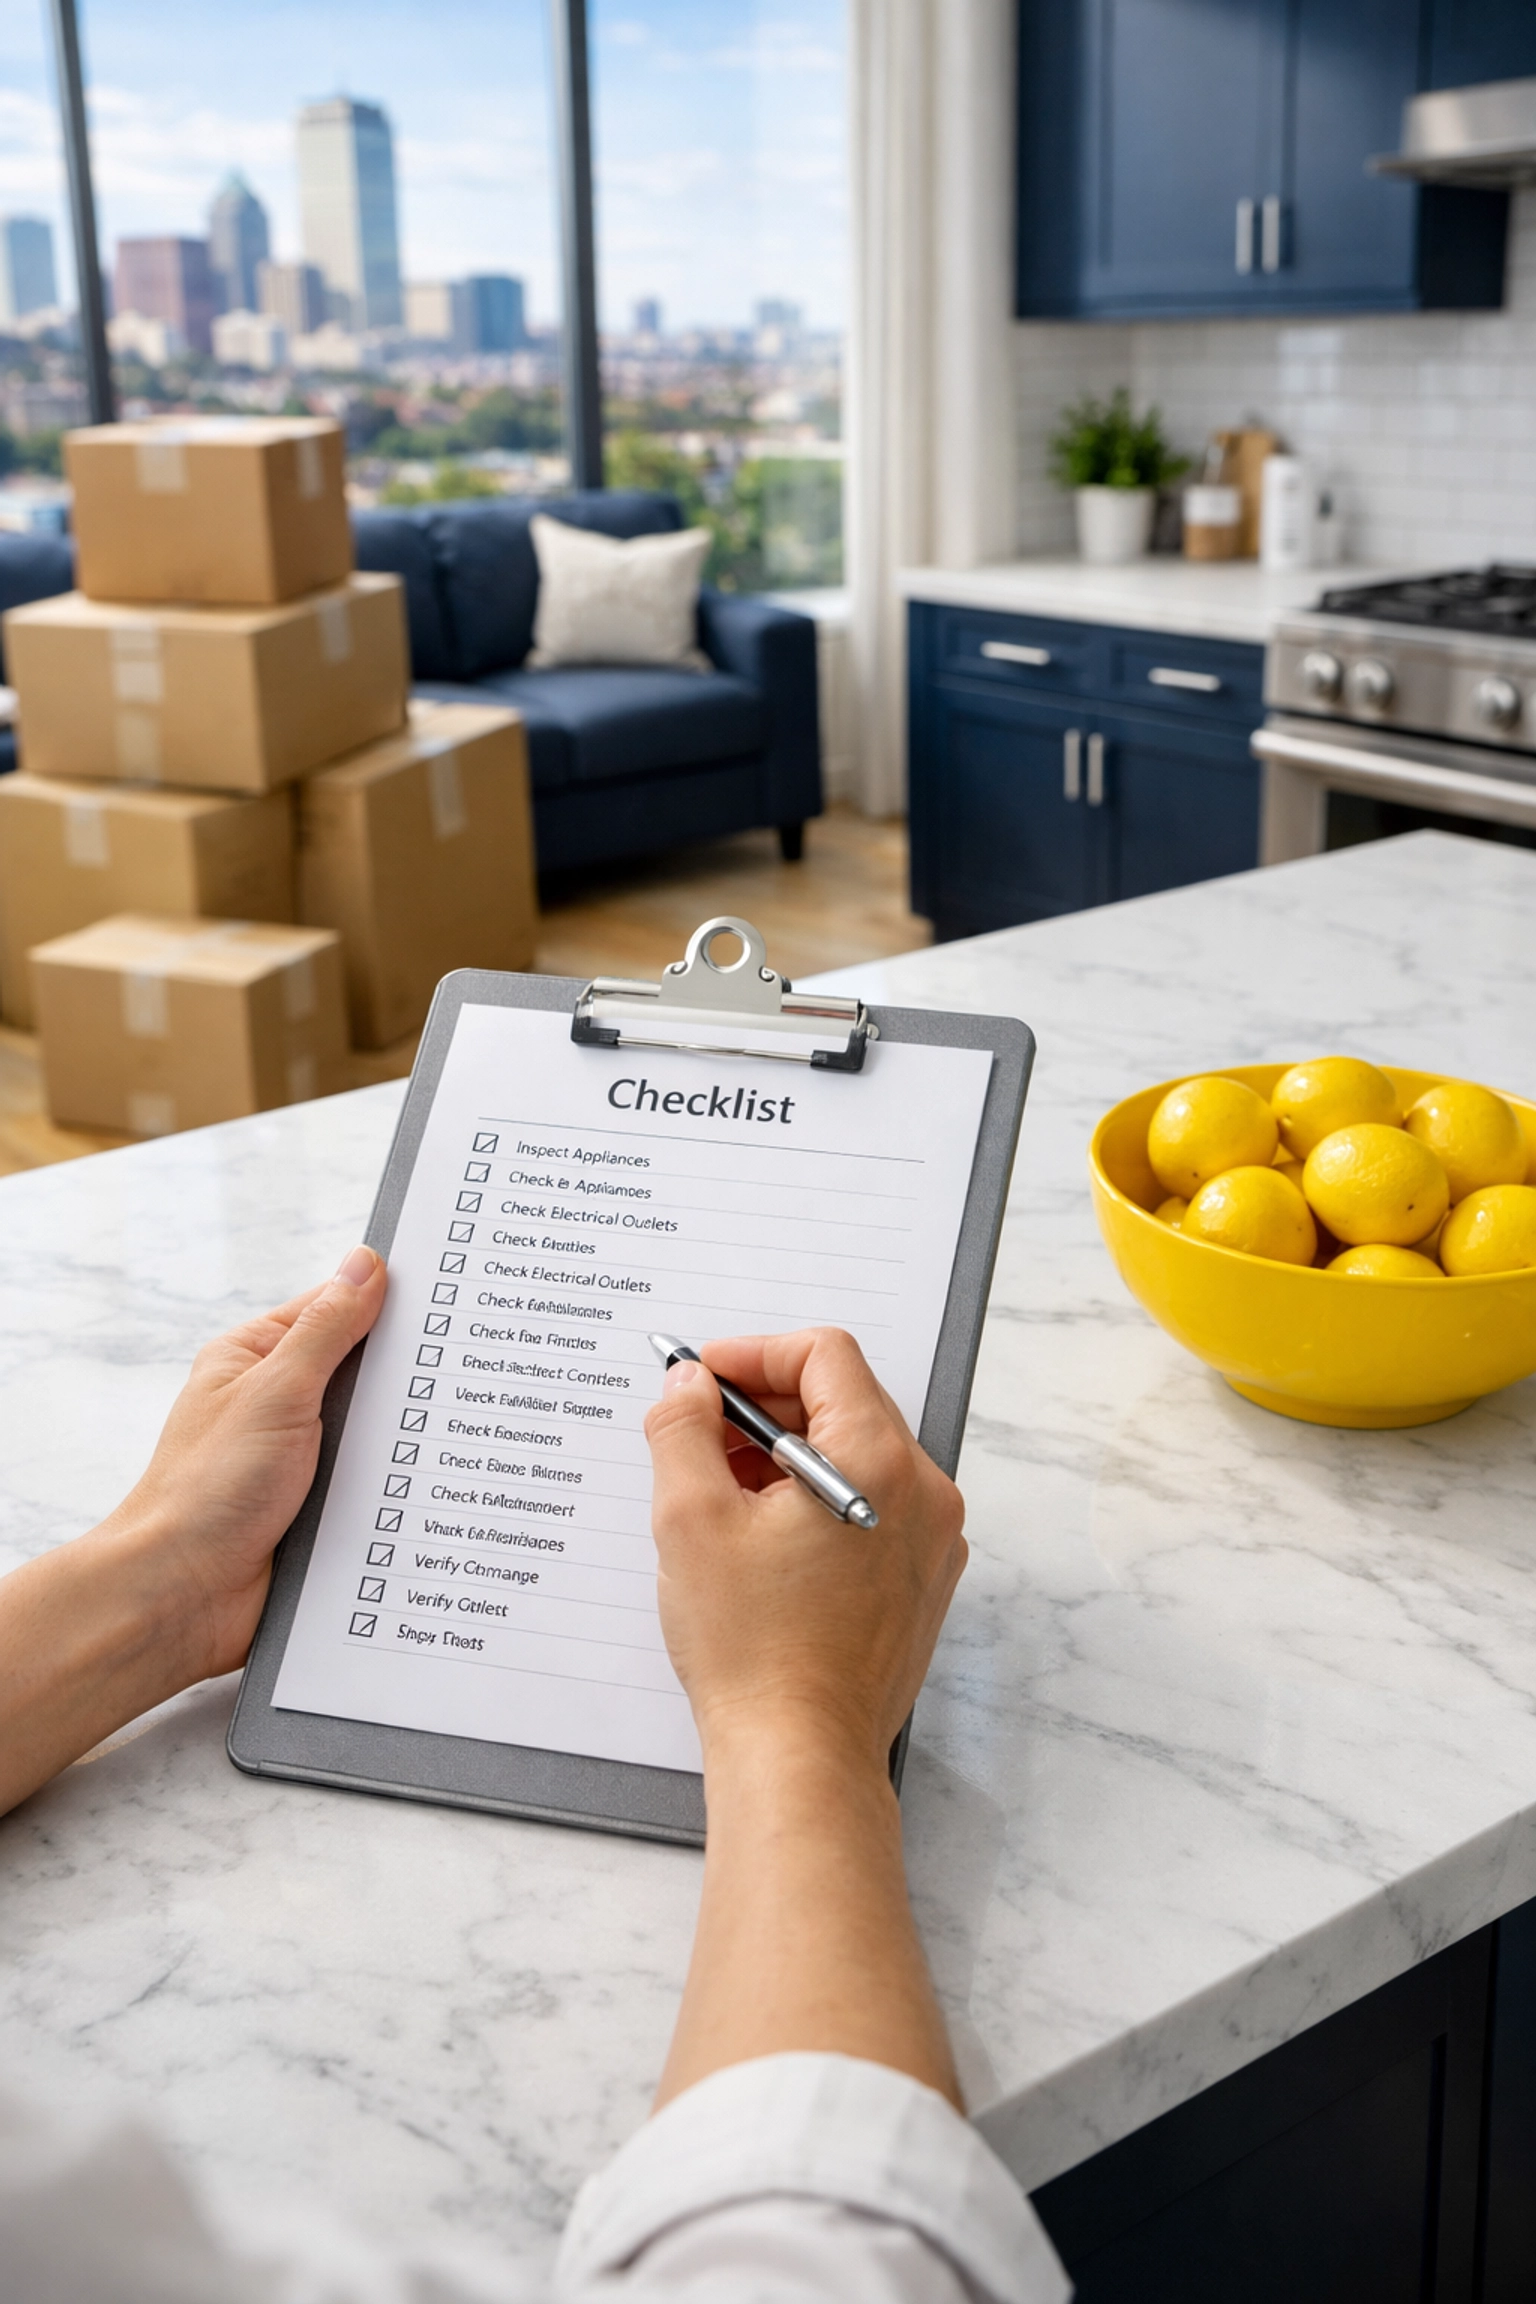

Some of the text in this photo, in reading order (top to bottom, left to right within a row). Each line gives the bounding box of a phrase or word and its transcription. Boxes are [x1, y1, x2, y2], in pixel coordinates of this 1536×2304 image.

[607, 1078, 795, 1124] Checklist
[516, 1141, 651, 1168] Inspect Appliances
[509, 1171, 554, 1188] Check
[500, 1201, 547, 1218] Check
[551, 1206, 619, 1225] Electrical
[492, 1230, 537, 1247] Check
[484, 1261, 652, 1293] Check Electrical Outlets
[477, 1292, 524, 1310] Check
[469, 1323, 515, 1341] Check
[430, 1485, 479, 1504] Check
[415, 1553, 460, 1575] Verify
[407, 1589, 453, 1611] Verify
